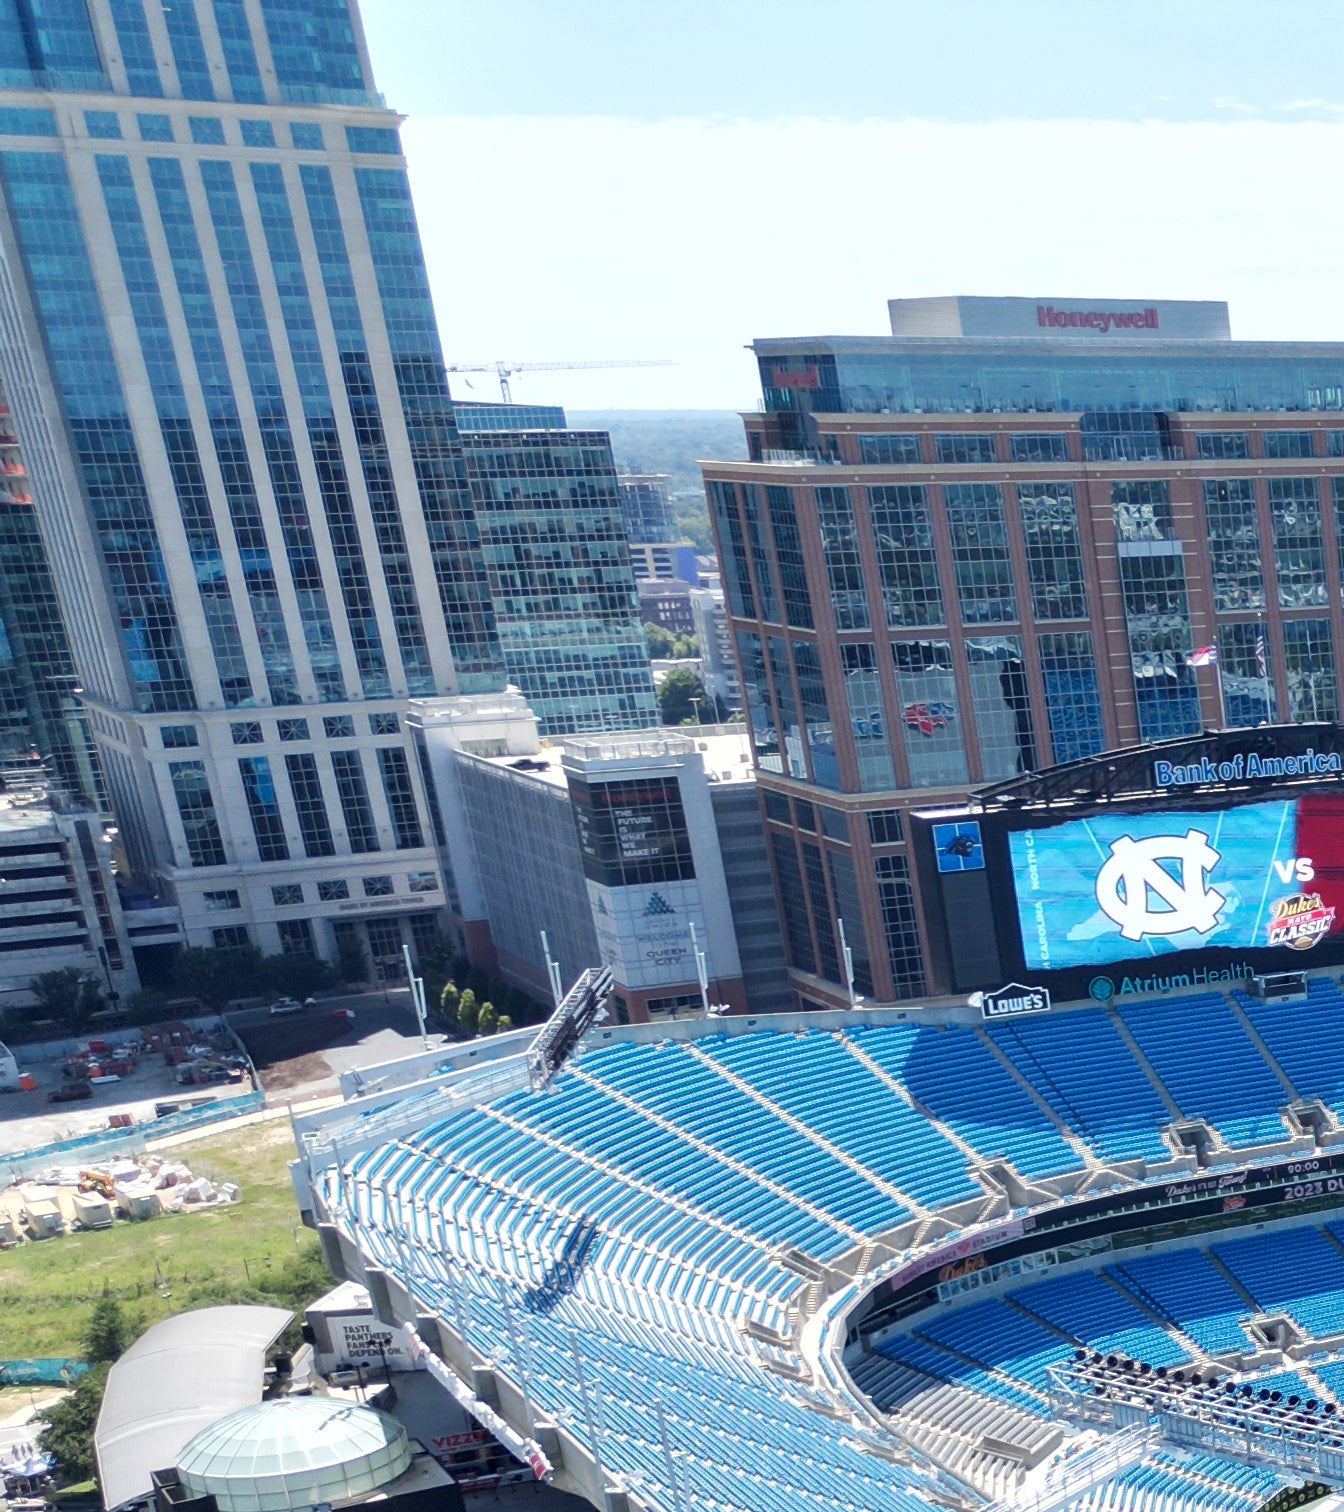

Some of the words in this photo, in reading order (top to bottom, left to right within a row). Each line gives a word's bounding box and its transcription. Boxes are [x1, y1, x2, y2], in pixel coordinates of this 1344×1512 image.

[1036, 305, 1159, 333] Honeywell
[1154, 756, 1218, 787] Bank
[1219, 753, 1243, 781] of
[1246, 748, 1342, 779] America
[1273, 857, 1315, 884] VS
[1268, 915, 1332, 946] CLASSIC
[1120, 976, 1189, 996] Atrium
[1193, 962, 1255, 985] Health
[1287, 1160, 1320, 1174] 90:00
[1284, 1182, 1324, 1201] 2023
[343, 1325, 370, 1333] TASTE
